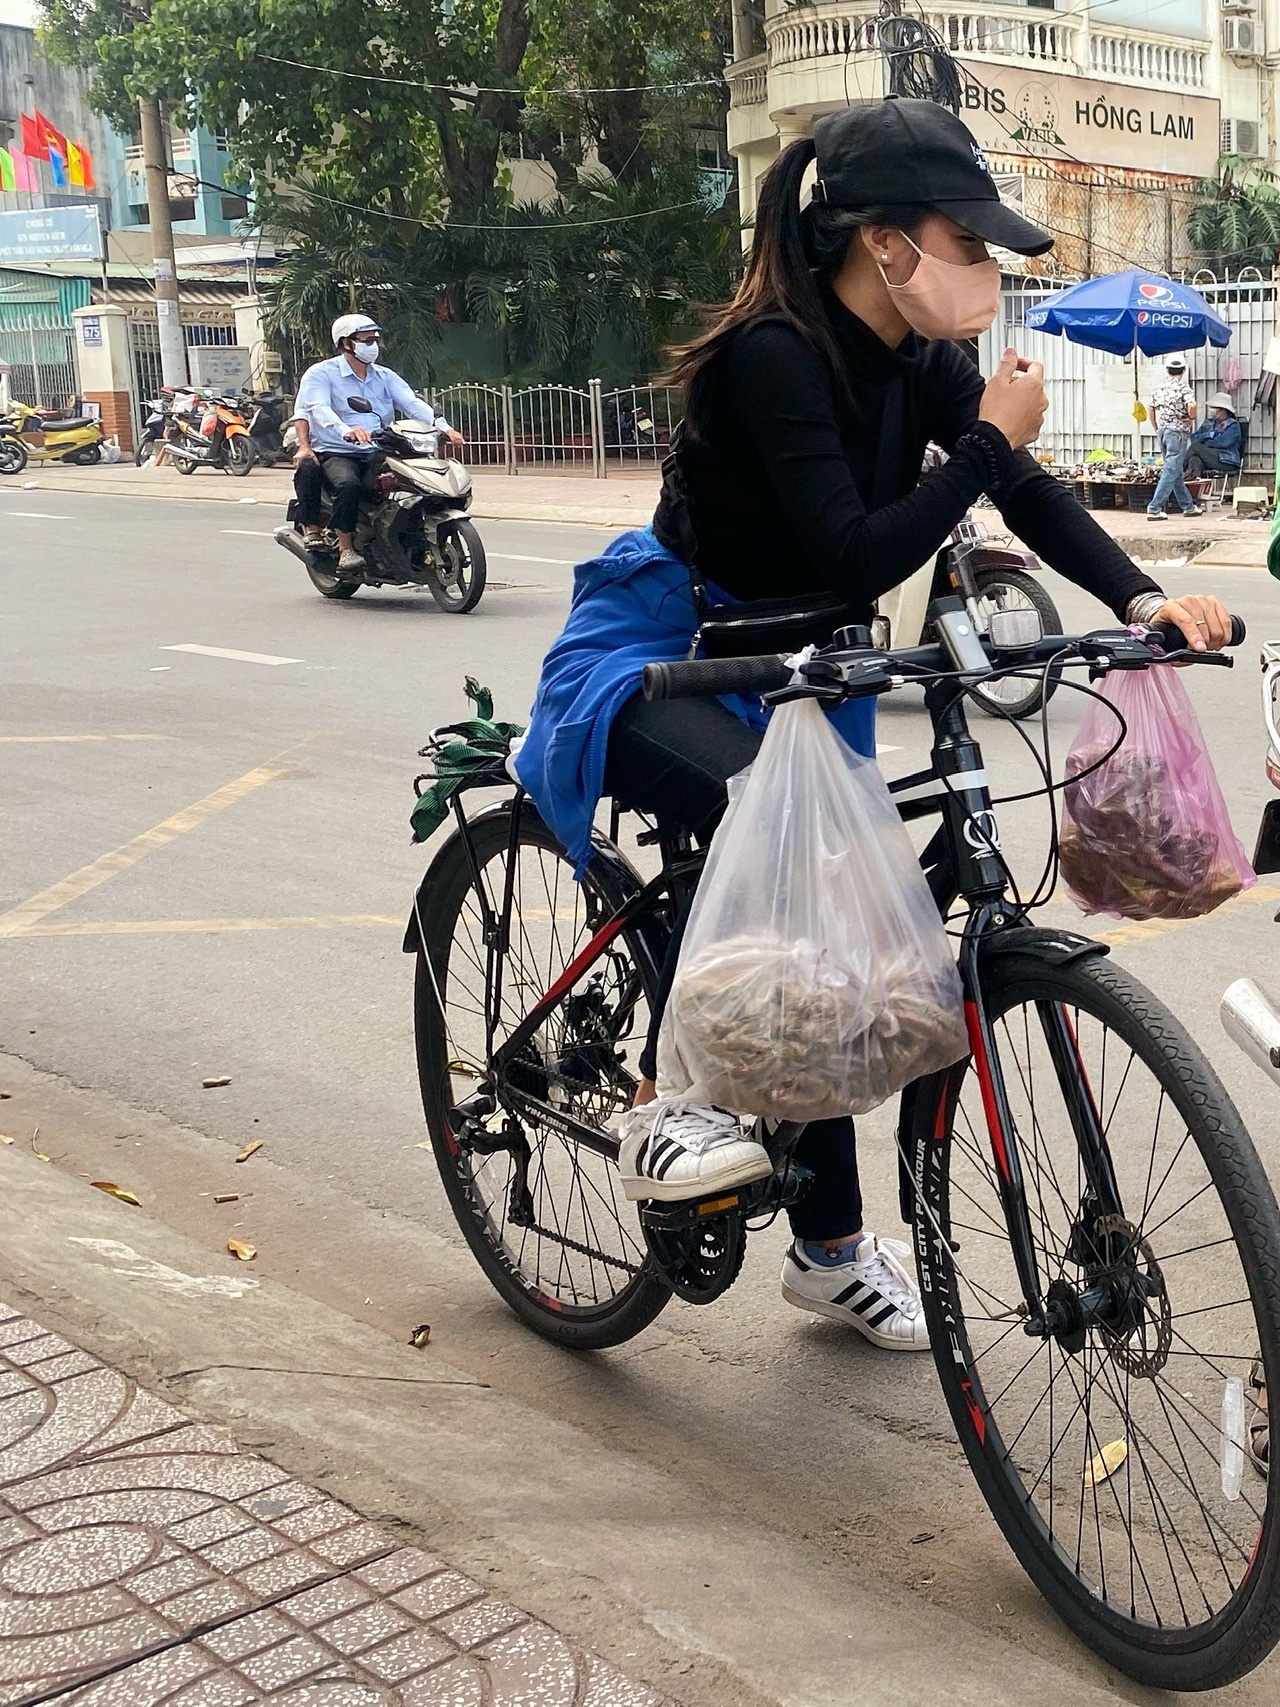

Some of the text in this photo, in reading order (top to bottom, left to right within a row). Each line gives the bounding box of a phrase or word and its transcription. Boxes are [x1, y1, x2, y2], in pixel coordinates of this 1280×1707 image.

[1075, 95, 1142, 134] HỒNG
[1150, 111, 1194, 140] LAM
[1021, 128, 1057, 144] VABIS
[1138, 299, 1188, 310] PEPSI
[1152, 312, 1193, 328] PEPSI
[84, 326, 100, 338] 675
[914, 1138, 933, 1292] CST CITY PARKOUR
